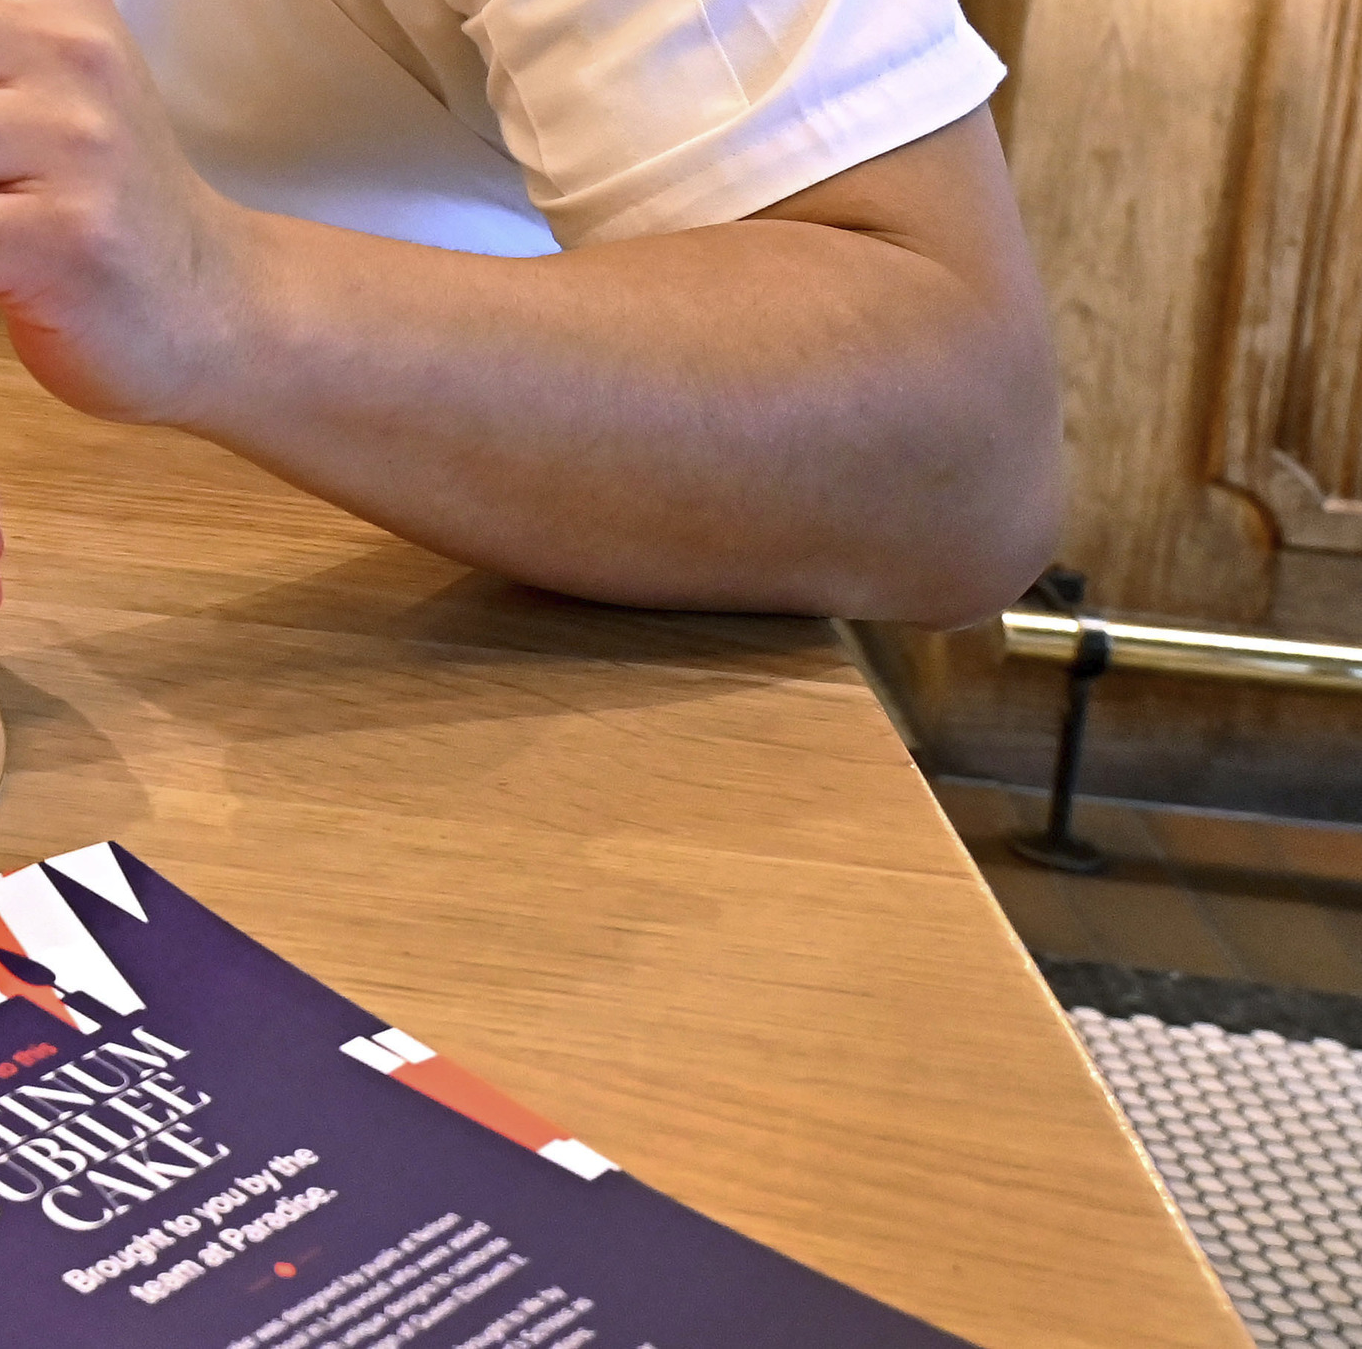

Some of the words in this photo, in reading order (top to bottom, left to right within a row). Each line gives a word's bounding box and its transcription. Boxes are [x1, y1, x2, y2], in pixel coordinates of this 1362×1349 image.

[12, 1042, 58, 1066] this
[41, 1122, 231, 1231] CAKE
[62, 1227, 176, 1294] Brought
[163, 1214, 201, 1237] to
[194, 1190, 247, 1226] you
[235, 1168, 281, 1198] by
[268, 1148, 320, 1177] the
[129, 1259, 206, 1304] team
[198, 1242, 234, 1267] at
[219, 1186, 339, 1251] Paradise.
